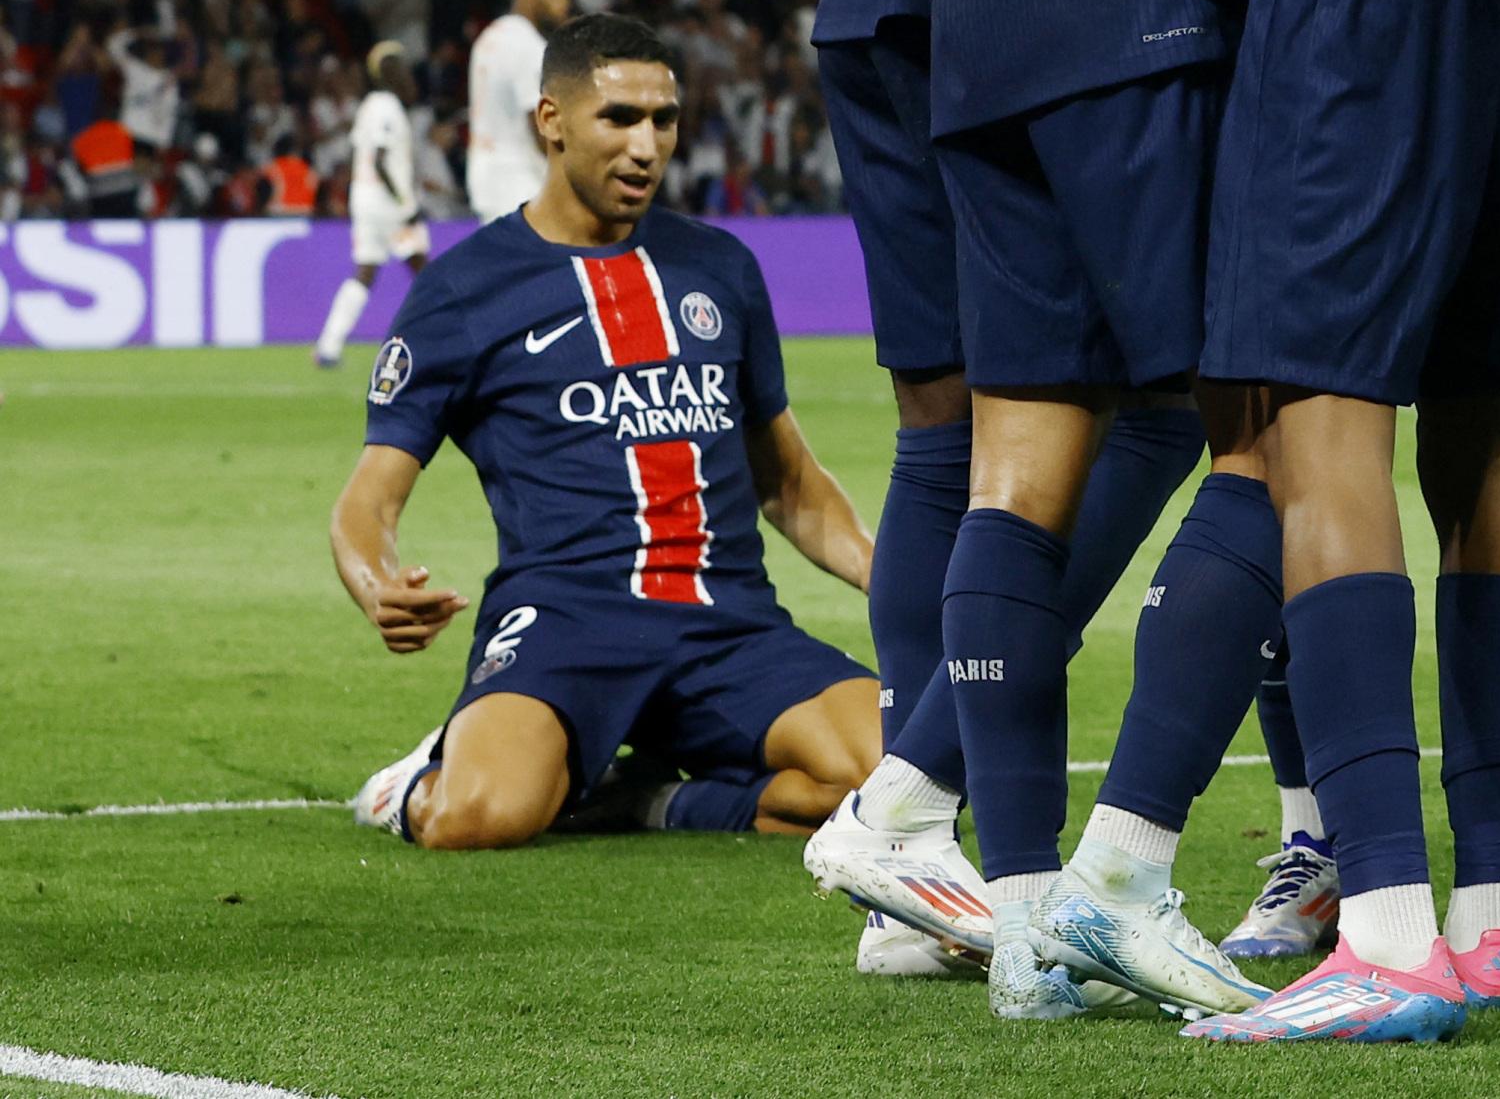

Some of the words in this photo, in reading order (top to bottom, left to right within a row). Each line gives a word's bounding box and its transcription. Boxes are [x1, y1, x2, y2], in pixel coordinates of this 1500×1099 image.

[559, 364, 730, 425] QATAR
[616, 407, 734, 440] AIRWAYS
[484, 605, 538, 658] 2
[948, 658, 1004, 684] PARIS
[1313, 981, 1391, 1006] F50
